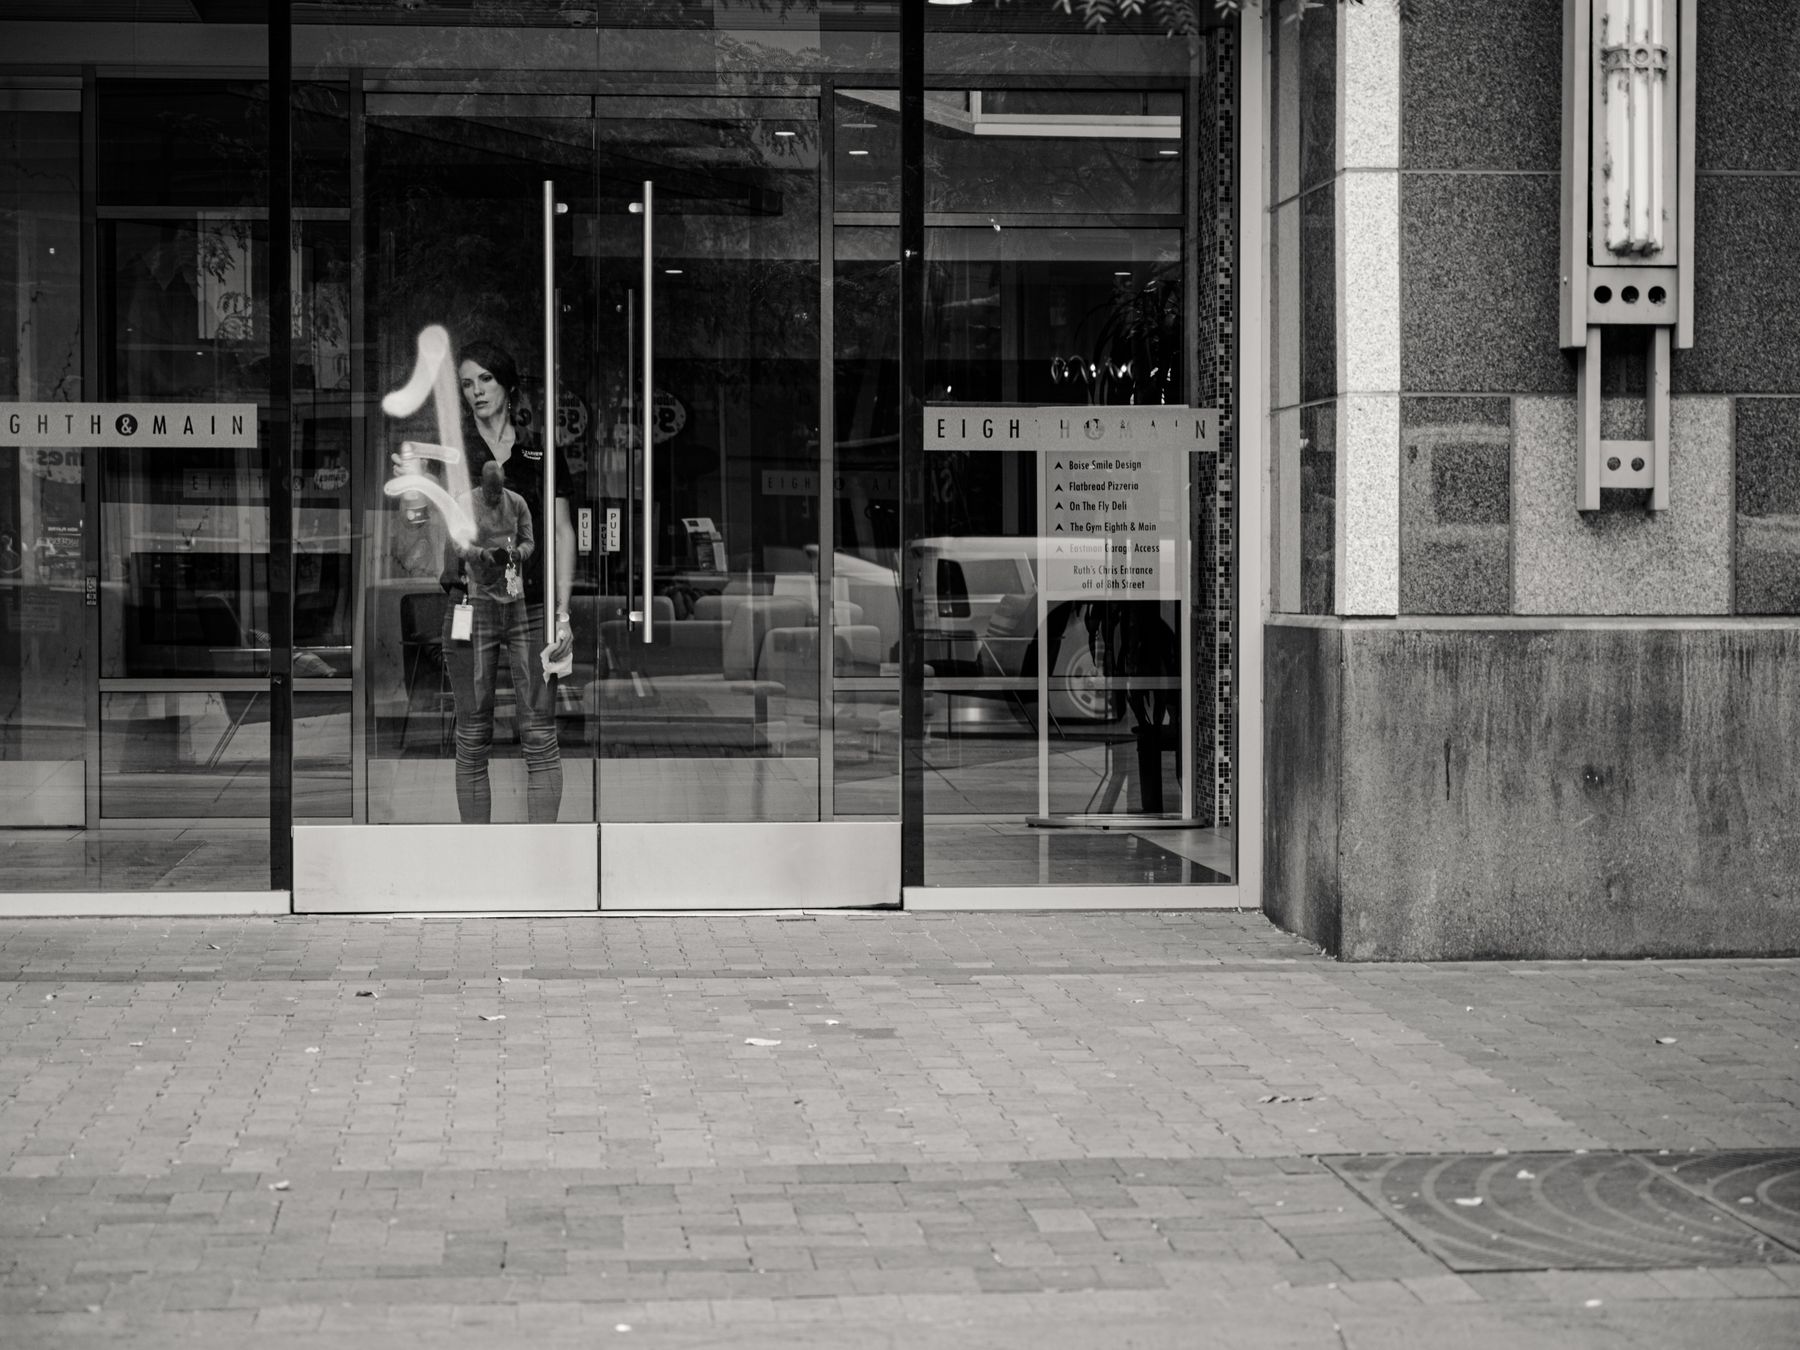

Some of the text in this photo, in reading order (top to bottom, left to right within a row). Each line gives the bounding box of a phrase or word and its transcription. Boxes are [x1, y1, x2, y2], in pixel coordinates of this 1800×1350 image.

[152, 415, 243, 435] MAIN
[937, 418, 1070, 439] EIGHH
[1118, 419, 1206, 439] MAN
[1069, 459, 1142, 471] Boise Smile Design
[1069, 480, 1139, 491] Flatbread Pizzeria
[1069, 501, 1127, 513] On The Fly Deli
[581, 512, 589, 547] PULL
[1070, 522, 1157, 534] The Gym Eighth & Main
[1070, 543, 1102, 553] Eastman
[1134, 543, 1160, 553] Access
[1073, 565, 1153, 575] Ruth's Chris Entrance
[1082, 579, 1145, 589] off of 8th Street
